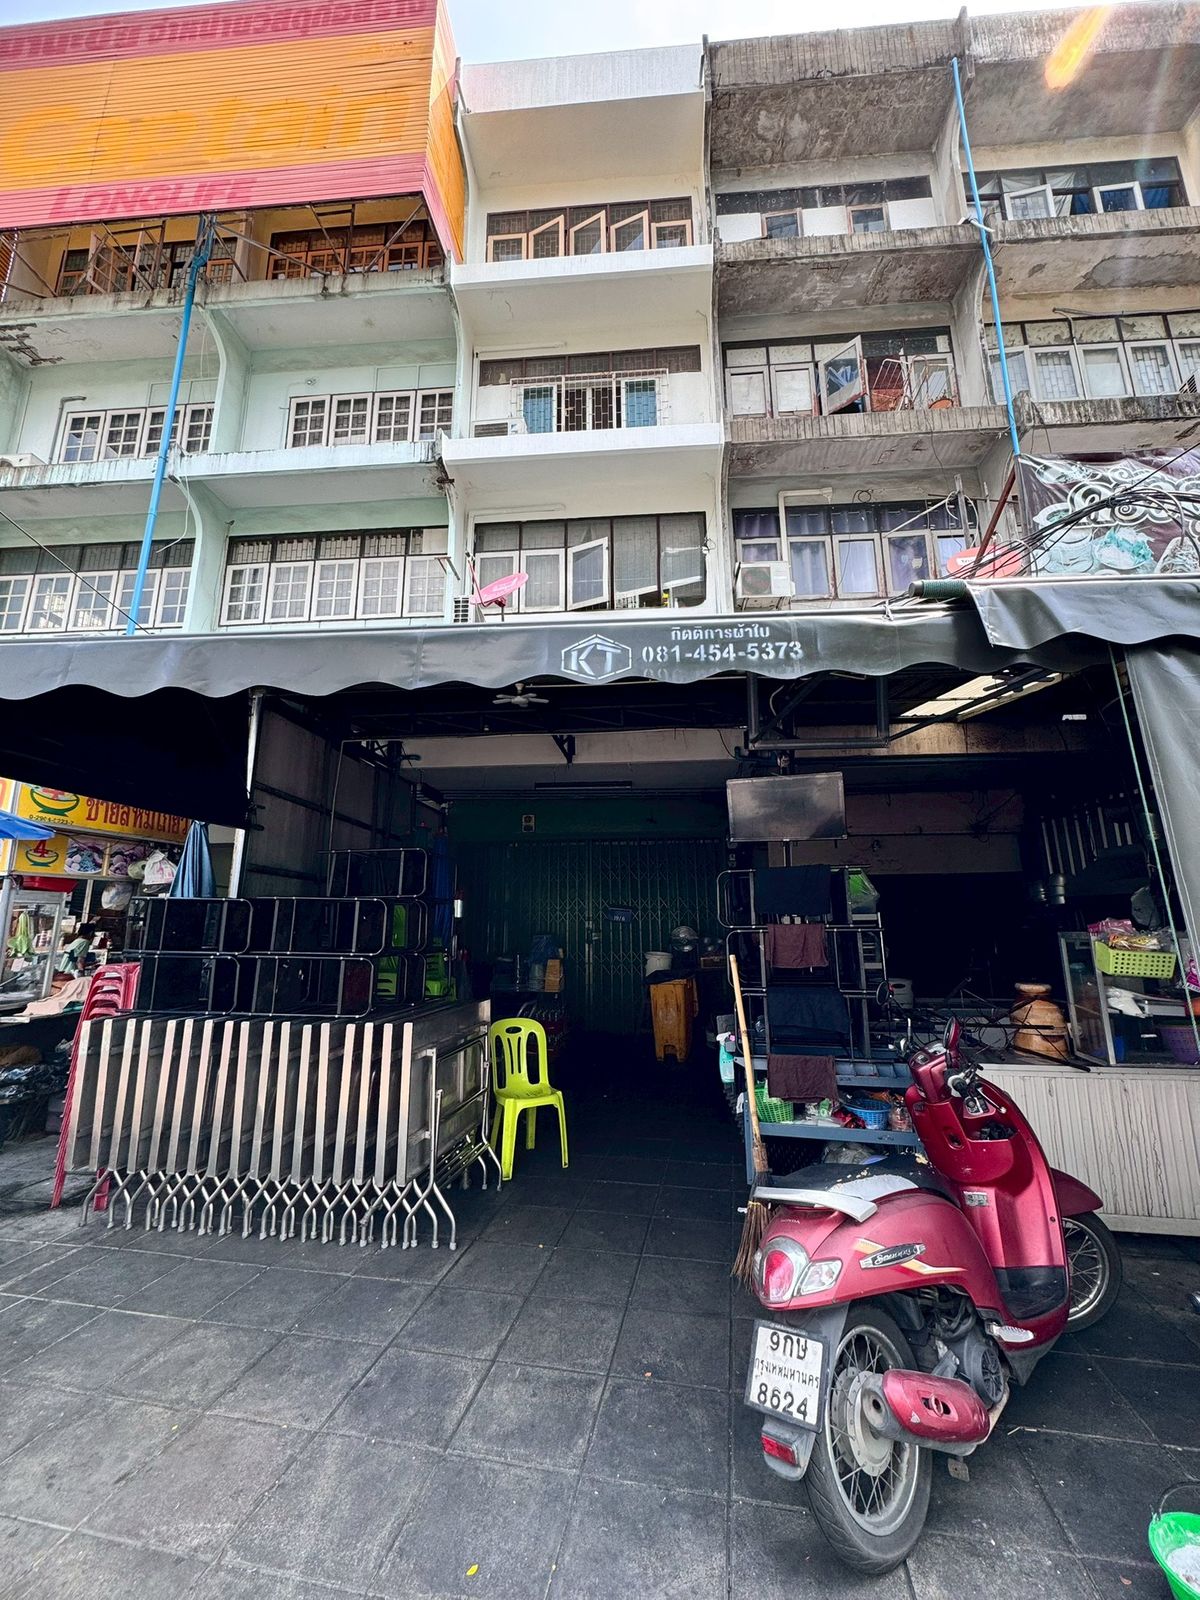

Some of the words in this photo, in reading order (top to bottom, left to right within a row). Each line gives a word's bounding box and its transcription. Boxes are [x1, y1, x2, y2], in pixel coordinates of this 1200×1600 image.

[49, 178, 258, 219] LONGLIFE
[641, 640, 804, 663] 081-454-5373
[754, 1357, 820, 1389] กรุงเทพมหานคร
[757, 1382, 808, 1421] 8624
